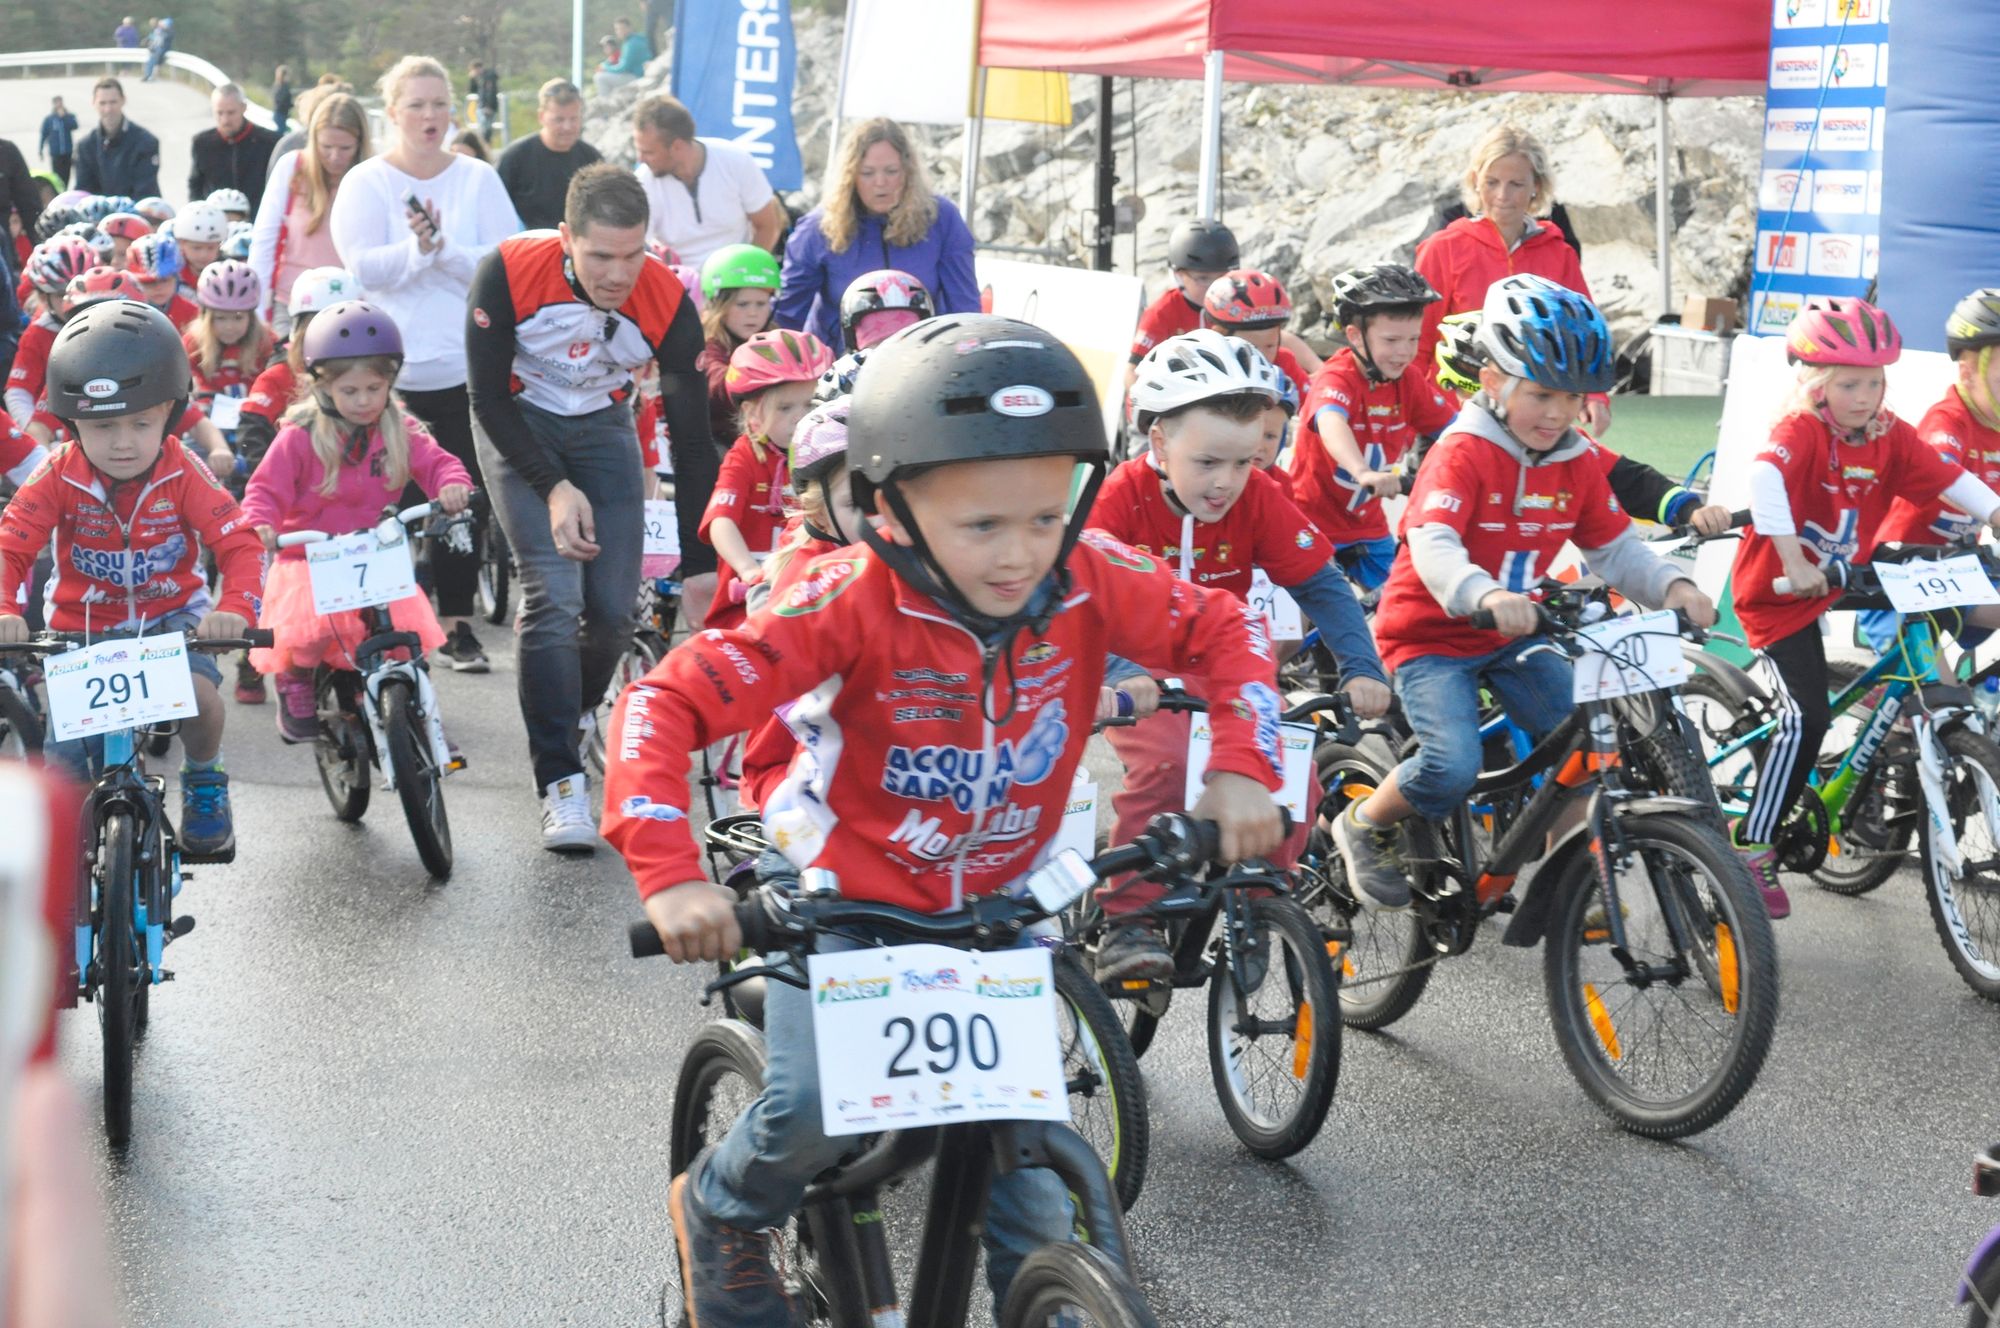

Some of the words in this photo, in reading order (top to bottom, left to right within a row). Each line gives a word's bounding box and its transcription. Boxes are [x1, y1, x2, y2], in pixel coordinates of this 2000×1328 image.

[731, 0, 780, 170] INTER
[88, 384, 112, 393] BELL
[1002, 395, 1043, 407] BELL
[352, 562, 368, 588] 7
[1913, 577, 1962, 598] 191
[717, 642, 760, 685] SWISS
[85, 670, 150, 710] 291
[888, 744, 1015, 784] ACQUA
[884, 769, 1009, 814] SAPON
[884, 1012, 1000, 1079] 290
